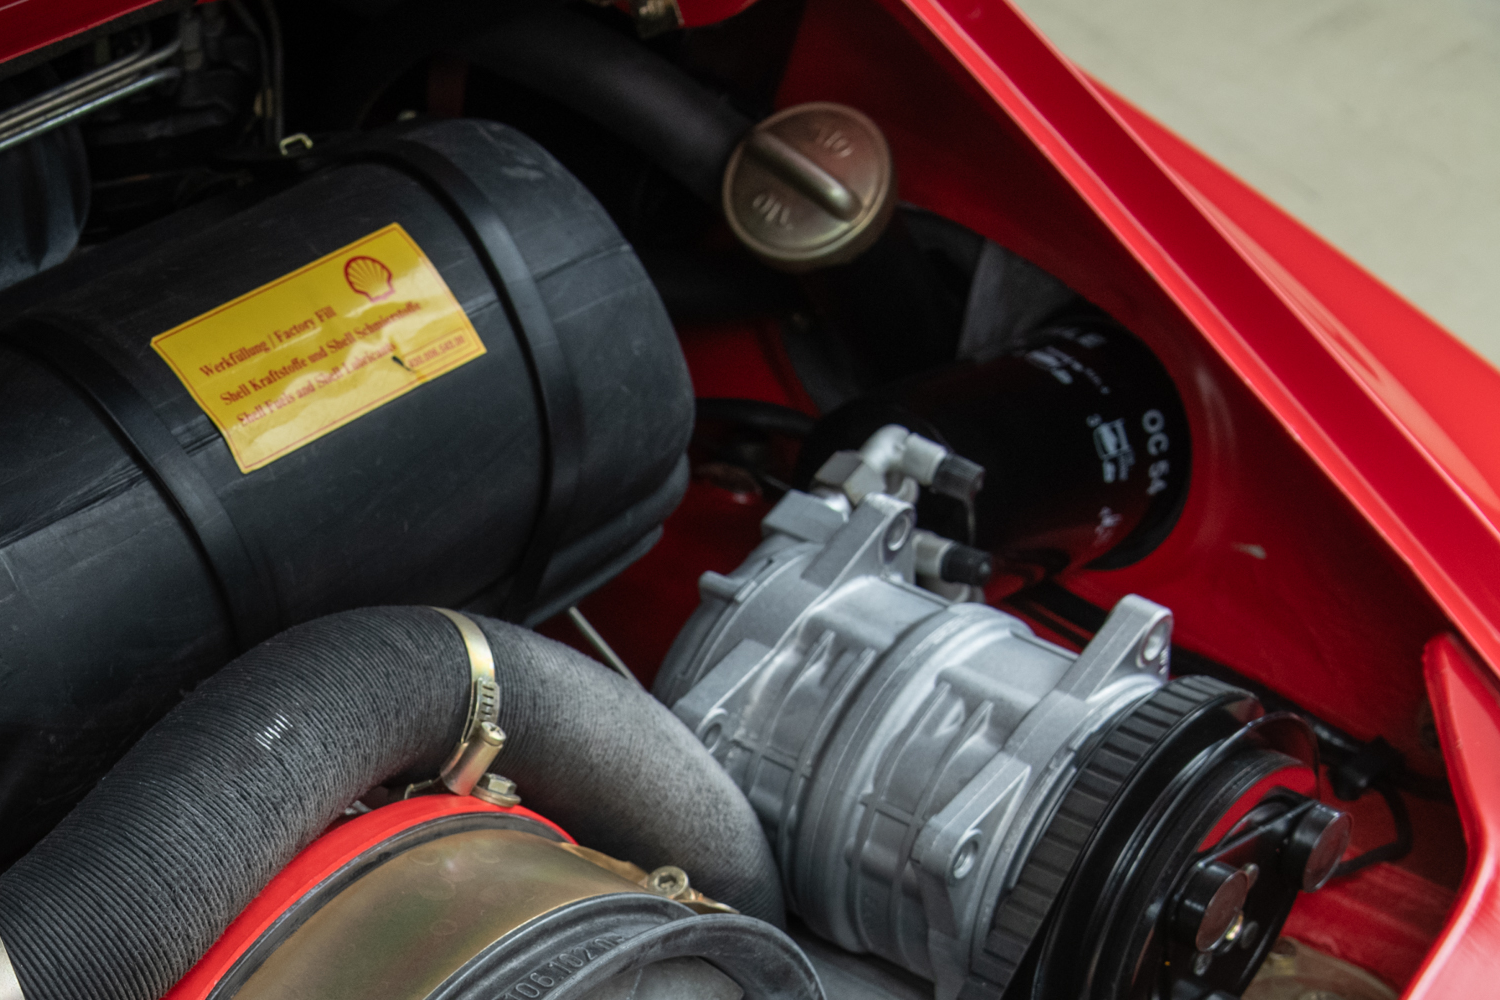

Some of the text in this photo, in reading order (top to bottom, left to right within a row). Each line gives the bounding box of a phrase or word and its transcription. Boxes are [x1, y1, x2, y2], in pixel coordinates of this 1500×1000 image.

[199, 341, 271, 377] Werkfüllung
[273, 318, 317, 343] Factory
[314, 306, 337, 323] Fill
[219, 301, 422, 406] Shell Kraftstoffe und Shell Schmierstoffe
[236, 404, 267, 428] Shell
[264, 392, 296, 414] Fuels
[295, 379, 316, 399] and
[314, 366, 343, 389] Shell
[341, 342, 397, 374] Lubricants
[1142, 408, 1171, 496] OC 54
